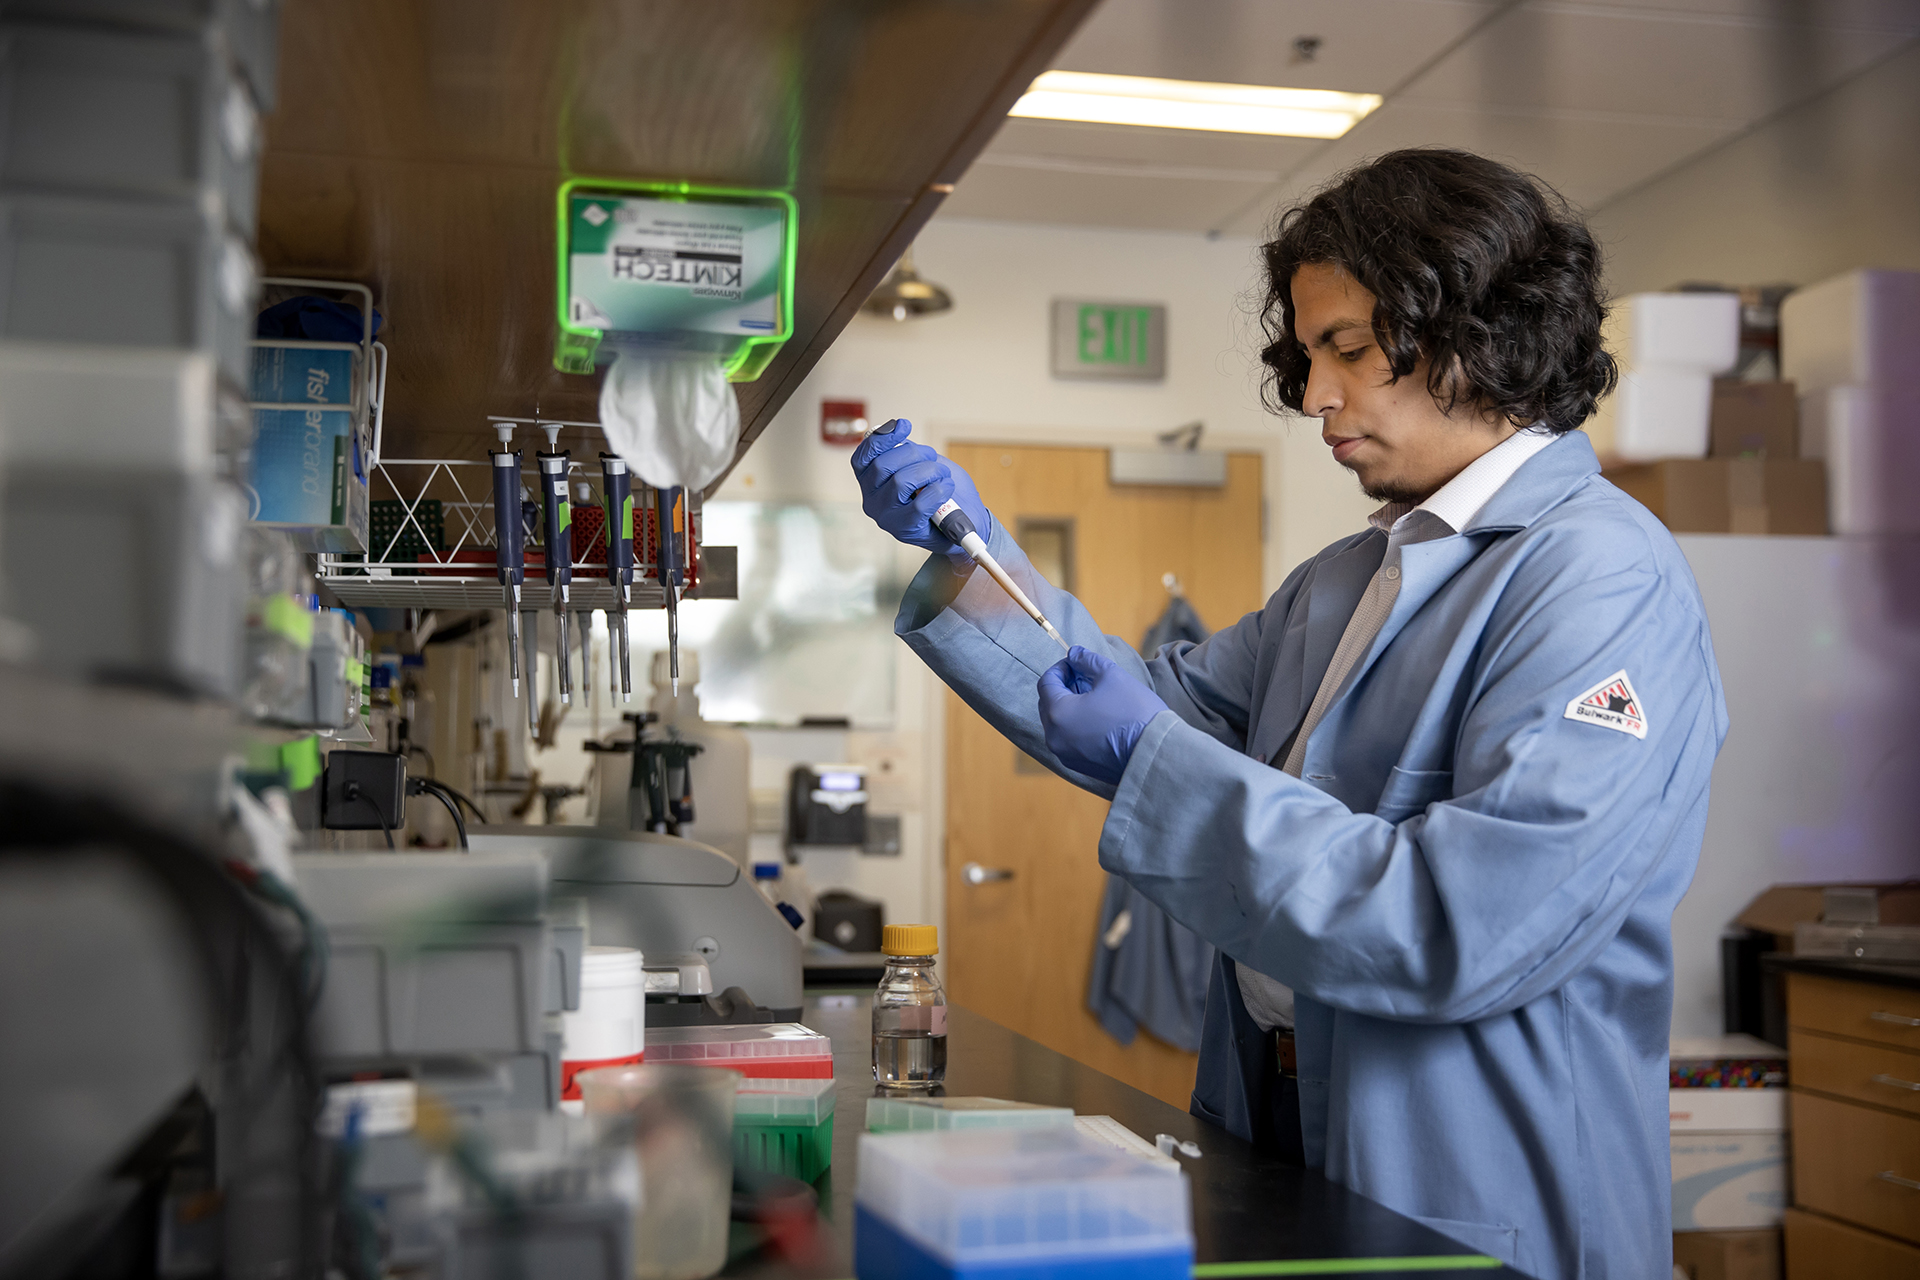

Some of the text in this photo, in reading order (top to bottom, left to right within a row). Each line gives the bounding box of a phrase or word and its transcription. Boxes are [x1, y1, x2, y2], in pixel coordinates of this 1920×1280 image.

[613, 259, 742, 287] KIMTECH
[1078, 304, 1150, 366] EXIT
[1576, 706, 1641, 731] Bulwark FR
